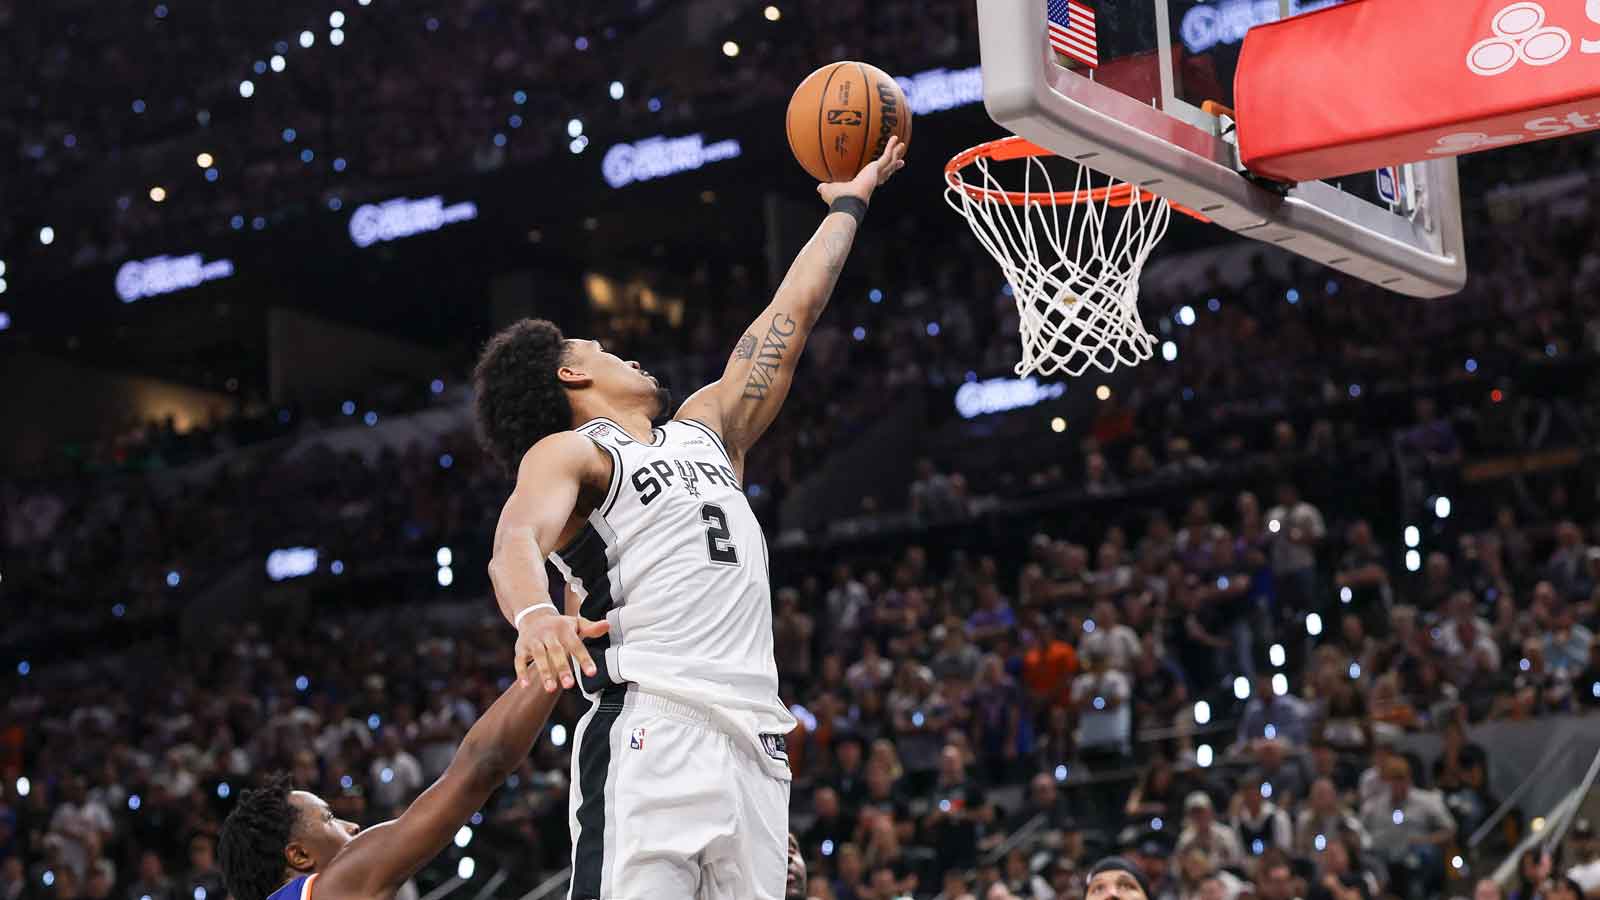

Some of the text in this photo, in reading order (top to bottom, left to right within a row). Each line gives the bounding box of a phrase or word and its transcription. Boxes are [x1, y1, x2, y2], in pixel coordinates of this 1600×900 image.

[741, 313, 796, 401] WAWG
[631, 459, 743, 506] SPURS
[700, 502, 742, 567] 2
